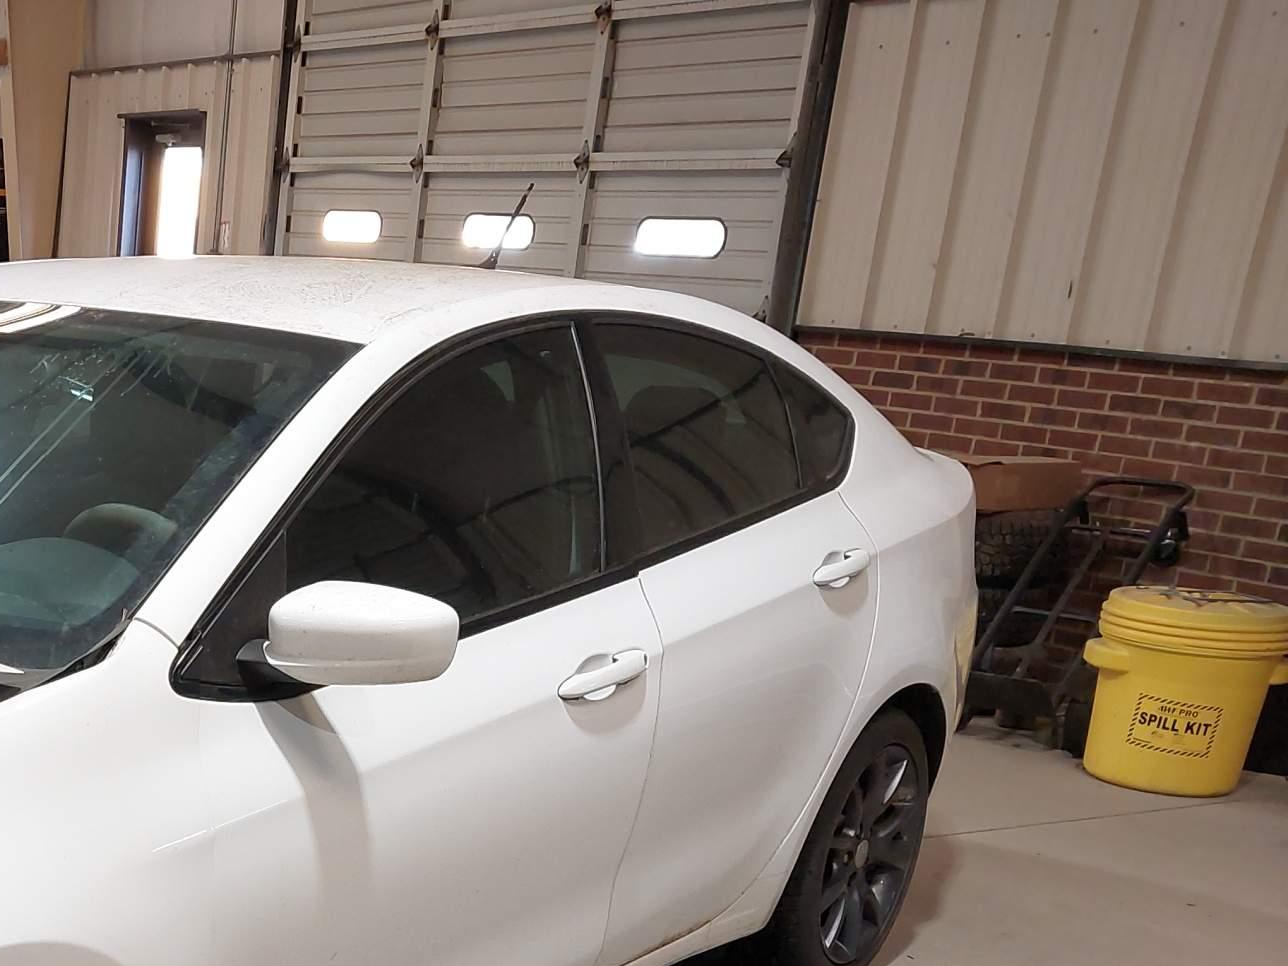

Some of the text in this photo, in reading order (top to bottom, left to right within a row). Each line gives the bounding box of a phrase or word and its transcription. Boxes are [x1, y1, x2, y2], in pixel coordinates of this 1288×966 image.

[1178, 708, 1199, 719] PRO
[1138, 711, 1212, 737] SPILL KIT
